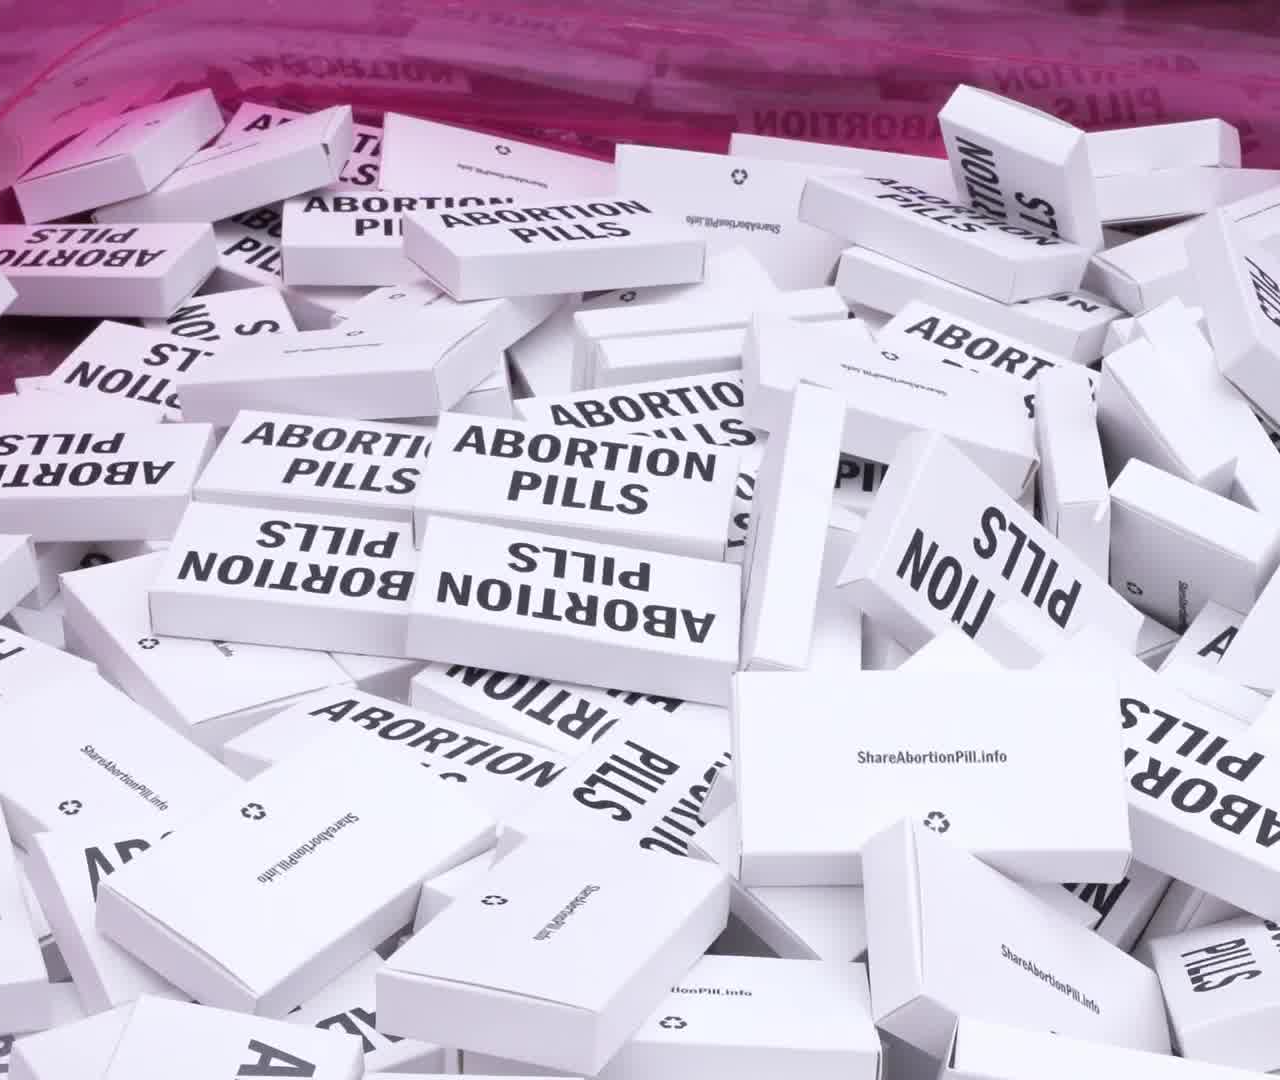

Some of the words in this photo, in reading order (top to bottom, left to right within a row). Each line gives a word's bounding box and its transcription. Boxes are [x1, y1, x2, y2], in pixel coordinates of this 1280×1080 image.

[25, 227, 139, 244] PILLS
[437, 199, 651, 228] ABORTION
[511, 221, 632, 246] PILLS
[864, 176, 1060, 247] ABORTION
[875, 193, 982, 234] PILLS
[904, 315, 1056, 383] ABORT
[282, 457, 421, 495] PILLS
[453, 424, 716, 483] ABORTION
[506, 470, 650, 515] PILLS
[255, 519, 400, 560] PILLS
[506, 541, 653, 592] PILLS
[972, 505, 1083, 630] PILLS
[176, 550, 416, 602] BORTION
[895, 528, 996, 638] TION
[435, 570, 716, 645] ABORTION
[308, 698, 567, 790] ABORTION
[856, 749, 1008, 767] ShareAbortionPill.info
[1118, 697, 1265, 782] PILLS
[79, 744, 169, 812] ShareAbortionPill.info
[573, 740, 680, 822] PILLS
[256, 812, 360, 884] ShareAbortionPill.info
[998, 943, 1102, 1016] ShareAbortionPill.info
[1181, 936, 1264, 993] PILLS
